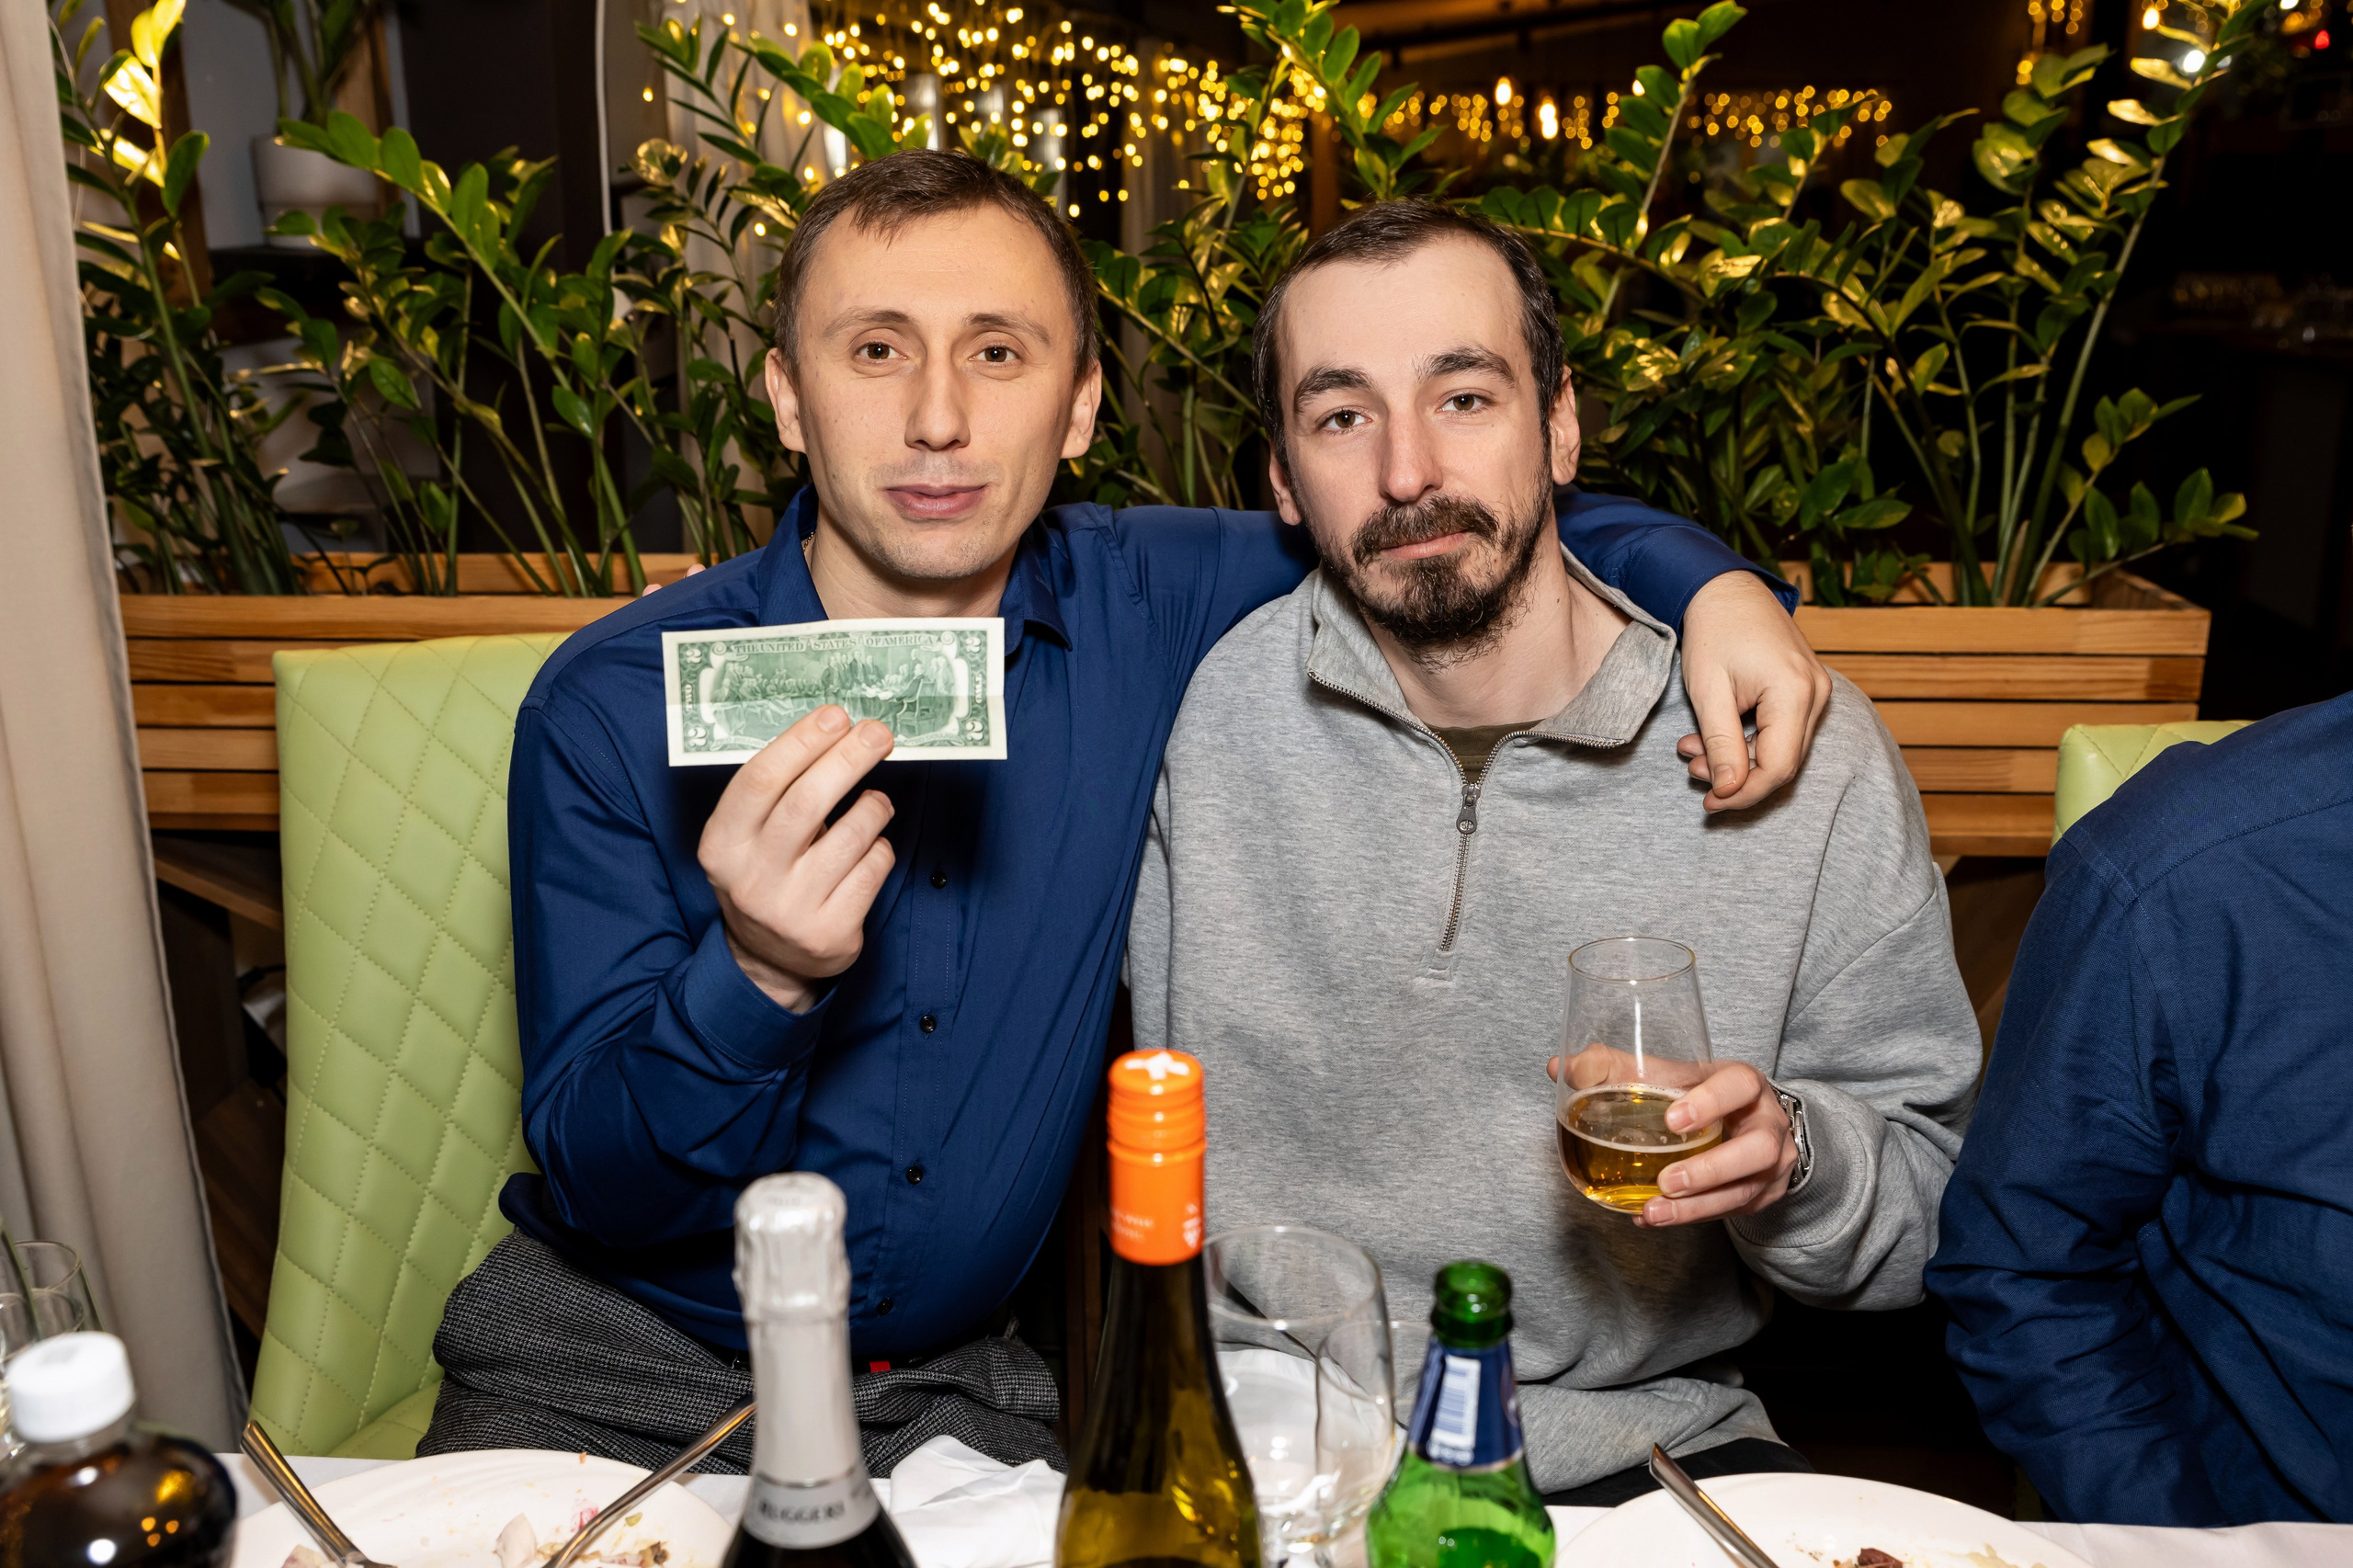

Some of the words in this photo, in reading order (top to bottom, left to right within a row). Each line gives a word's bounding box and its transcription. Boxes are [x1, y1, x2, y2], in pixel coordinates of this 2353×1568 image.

[734, 644, 759, 653] THE
[761, 642, 804, 653] UNITED
[813, 638, 857, 651] STATES
[866, 637, 881, 646] OF
[882, 635, 933, 646] AMERICA
[966, 637, 981, 653] 2
[686, 648, 701, 664] 2
[685, 684, 693, 711] TWO
[975, 674, 983, 703] TWO
[688, 727, 707, 746] 2
[966, 721, 983, 741] 2
